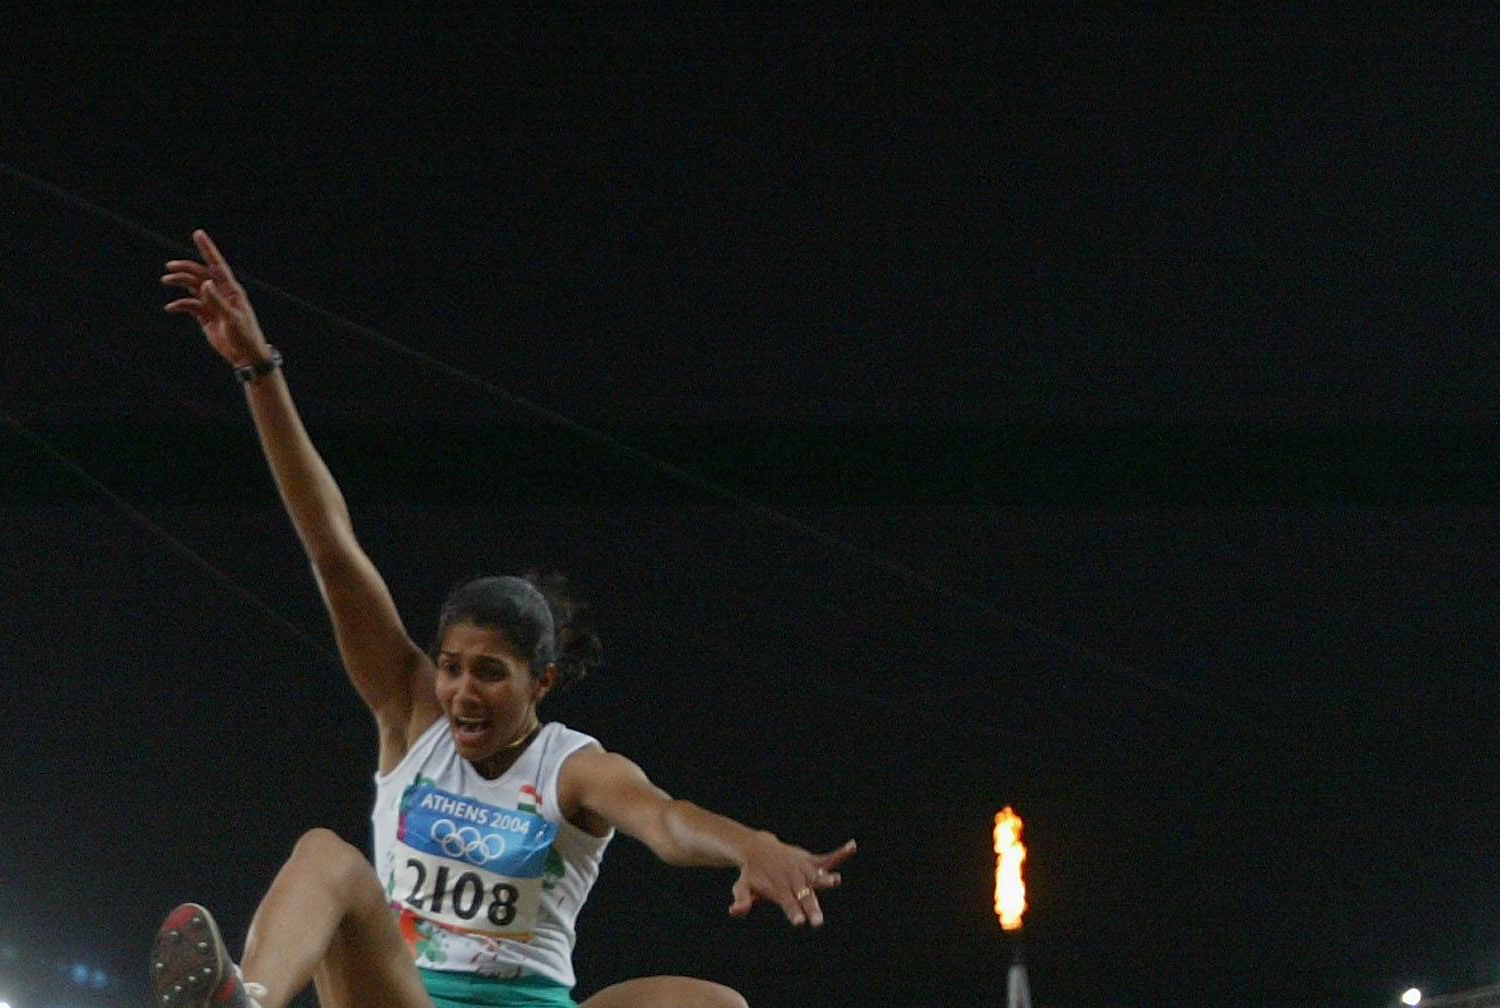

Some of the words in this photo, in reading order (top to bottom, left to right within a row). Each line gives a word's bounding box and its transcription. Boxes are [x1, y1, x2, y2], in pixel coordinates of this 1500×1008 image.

[420, 793, 489, 825] ATHENS
[489, 812, 531, 835] 2004
[406, 859, 518, 926] 2108
